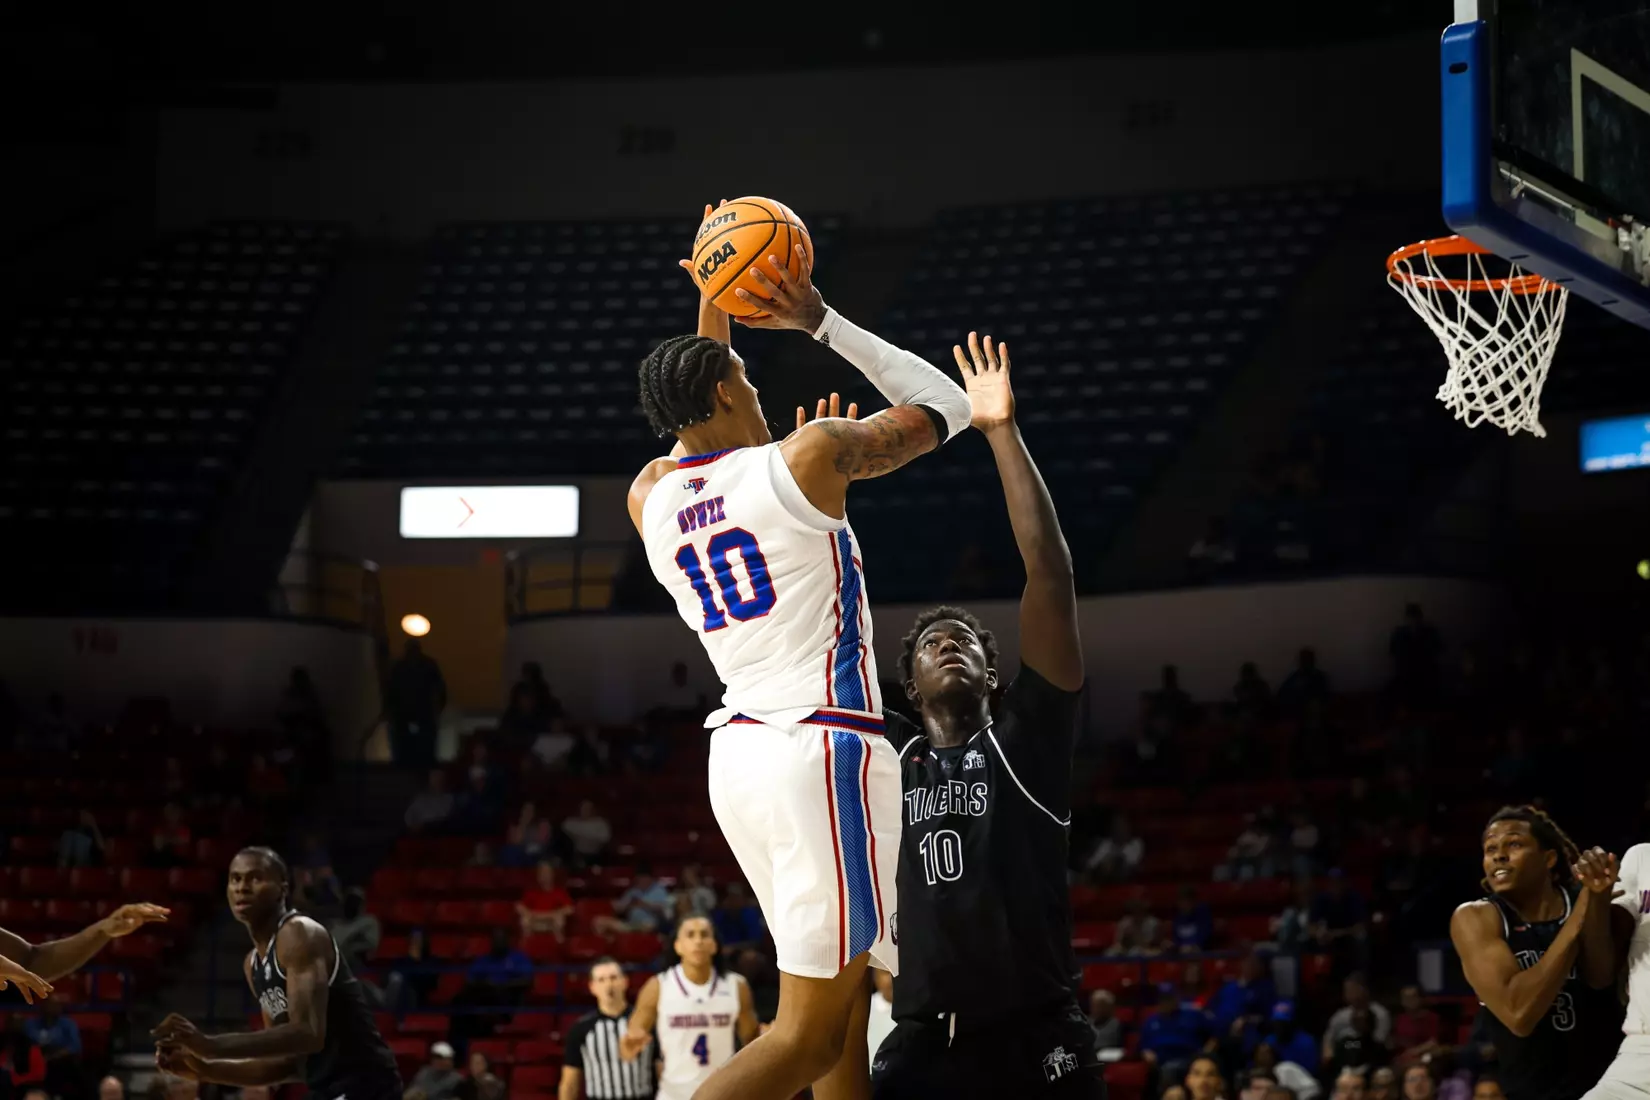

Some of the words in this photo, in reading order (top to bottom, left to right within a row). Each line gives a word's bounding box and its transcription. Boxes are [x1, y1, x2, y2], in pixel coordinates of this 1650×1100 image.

[697, 241, 737, 285] NCAA
[675, 527, 777, 633] 10
[919, 829, 964, 885] 10
[692, 1032, 709, 1066] 4
